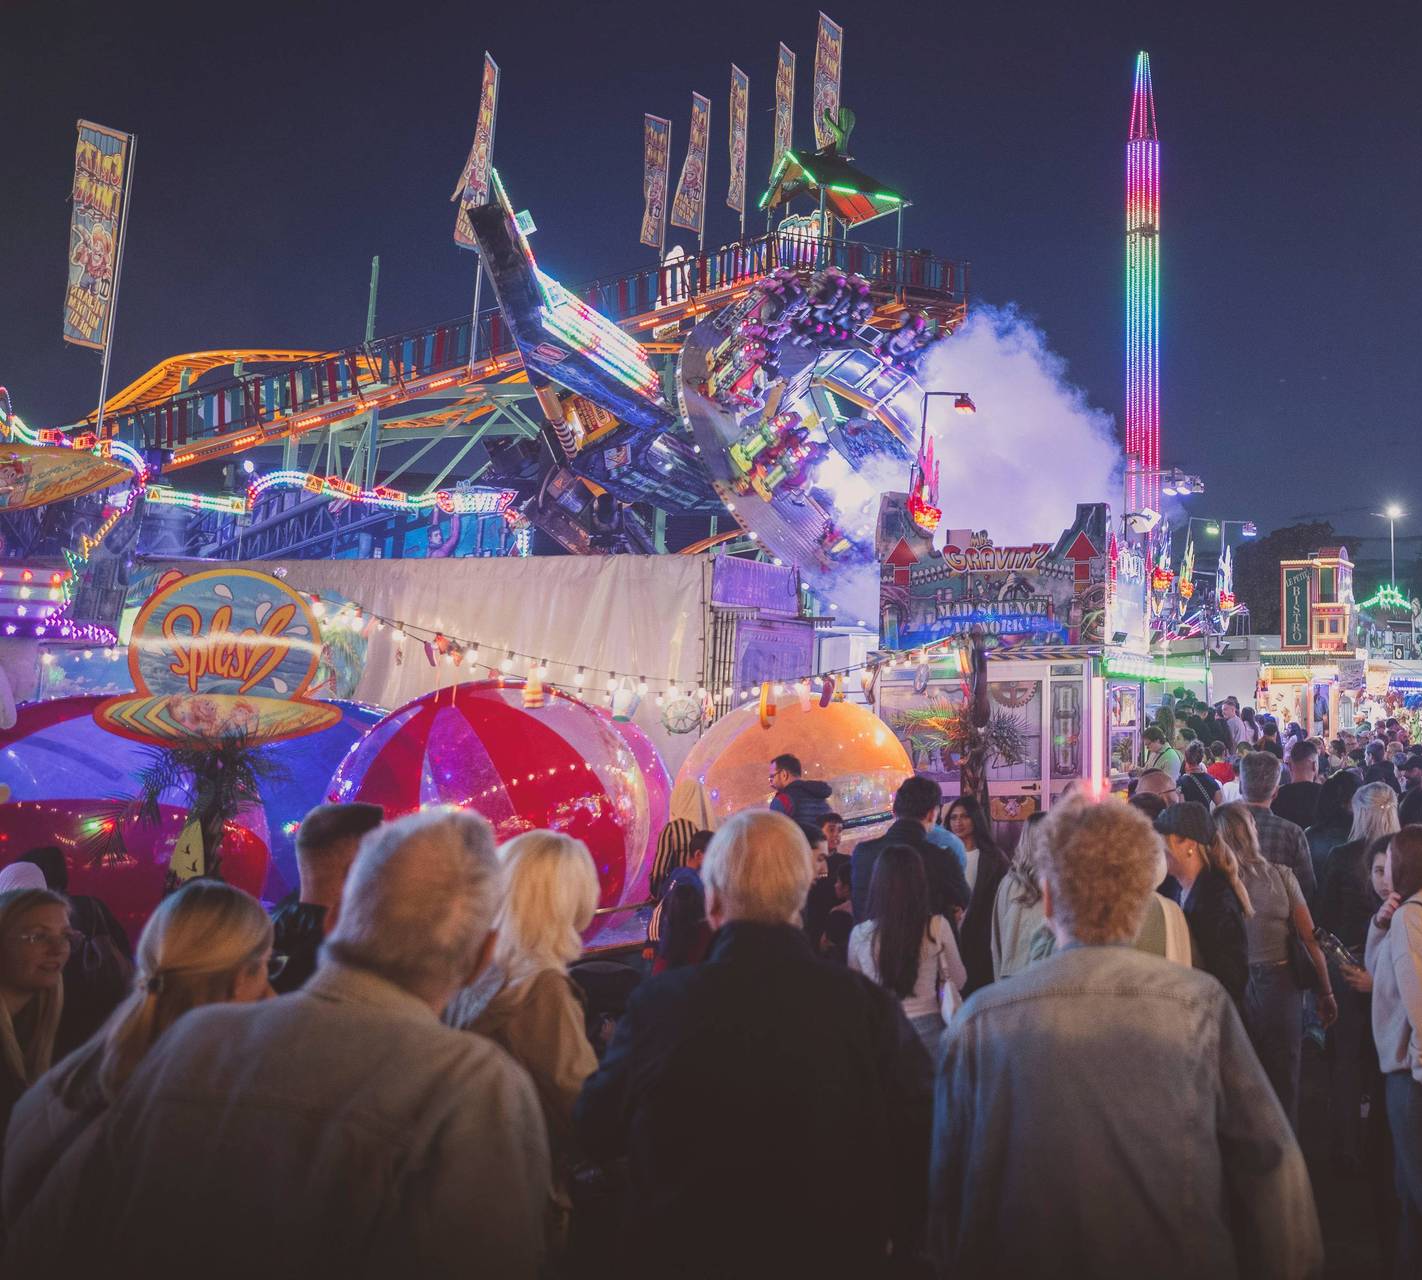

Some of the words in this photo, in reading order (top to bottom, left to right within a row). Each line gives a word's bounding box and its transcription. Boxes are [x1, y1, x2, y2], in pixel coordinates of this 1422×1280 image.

[942, 543, 1051, 573] GRAVITY
[937, 603, 973, 618] MAD
[976, 601, 1047, 617] SCIENCE
[1292, 586, 1302, 641] BISTRO
[162, 604, 296, 693] Splash
